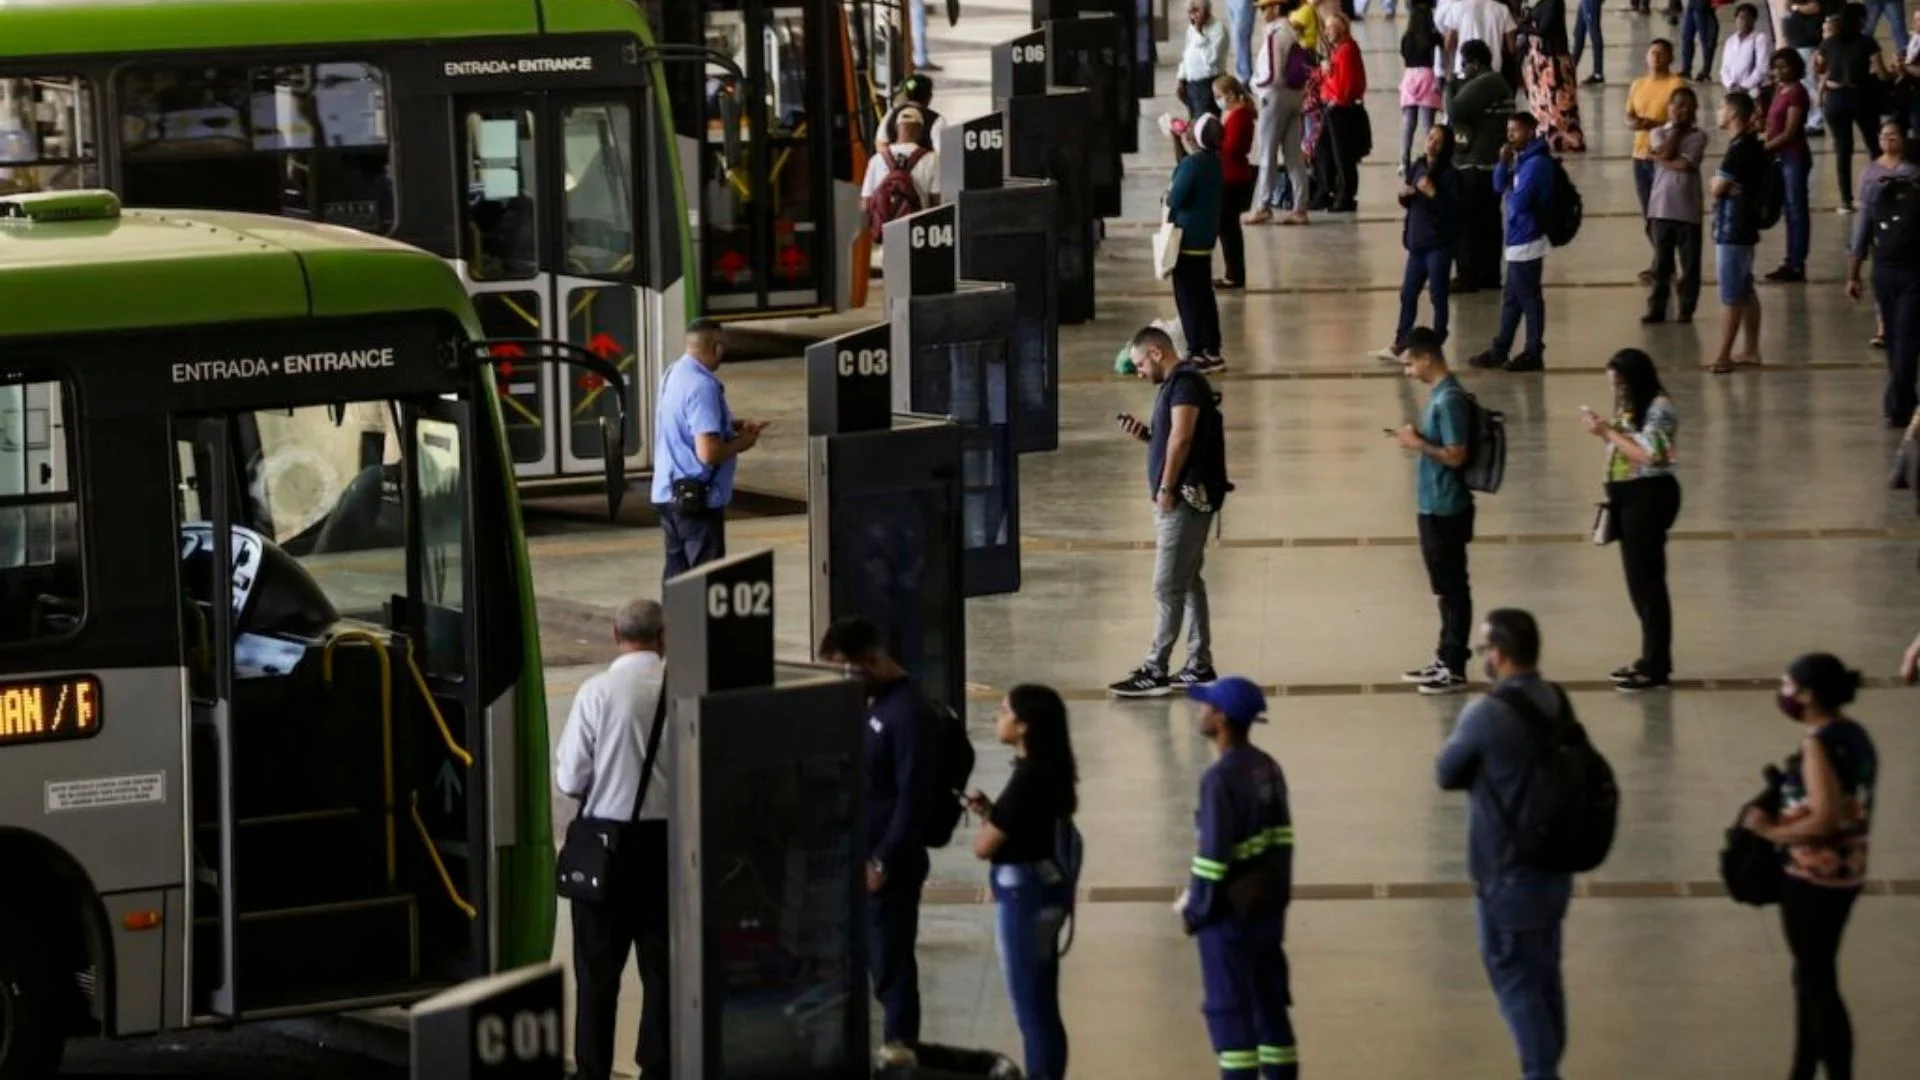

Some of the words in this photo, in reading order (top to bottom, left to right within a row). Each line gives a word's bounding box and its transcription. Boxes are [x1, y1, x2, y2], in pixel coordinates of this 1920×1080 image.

[444, 60, 510, 76] ENTRADA
[517, 56, 592, 73] ENTRANCE
[1012, 45, 1022, 64] C
[1025, 44, 1045, 63] 06
[965, 130, 977, 150] C
[980, 129, 1002, 149] 05
[912, 226, 925, 248] C
[928, 224, 954, 247] 04
[171, 358, 269, 383] ENTRADA
[284, 347, 394, 374] ENTRANCE
[839, 350, 853, 375] C
[859, 348, 888, 375] 03
[708, 582, 728, 618] C
[733, 580, 772, 617] 02
[0, 686, 43, 736] AN
[478, 1013, 505, 1065] C
[512, 1007, 558, 1060] 01
